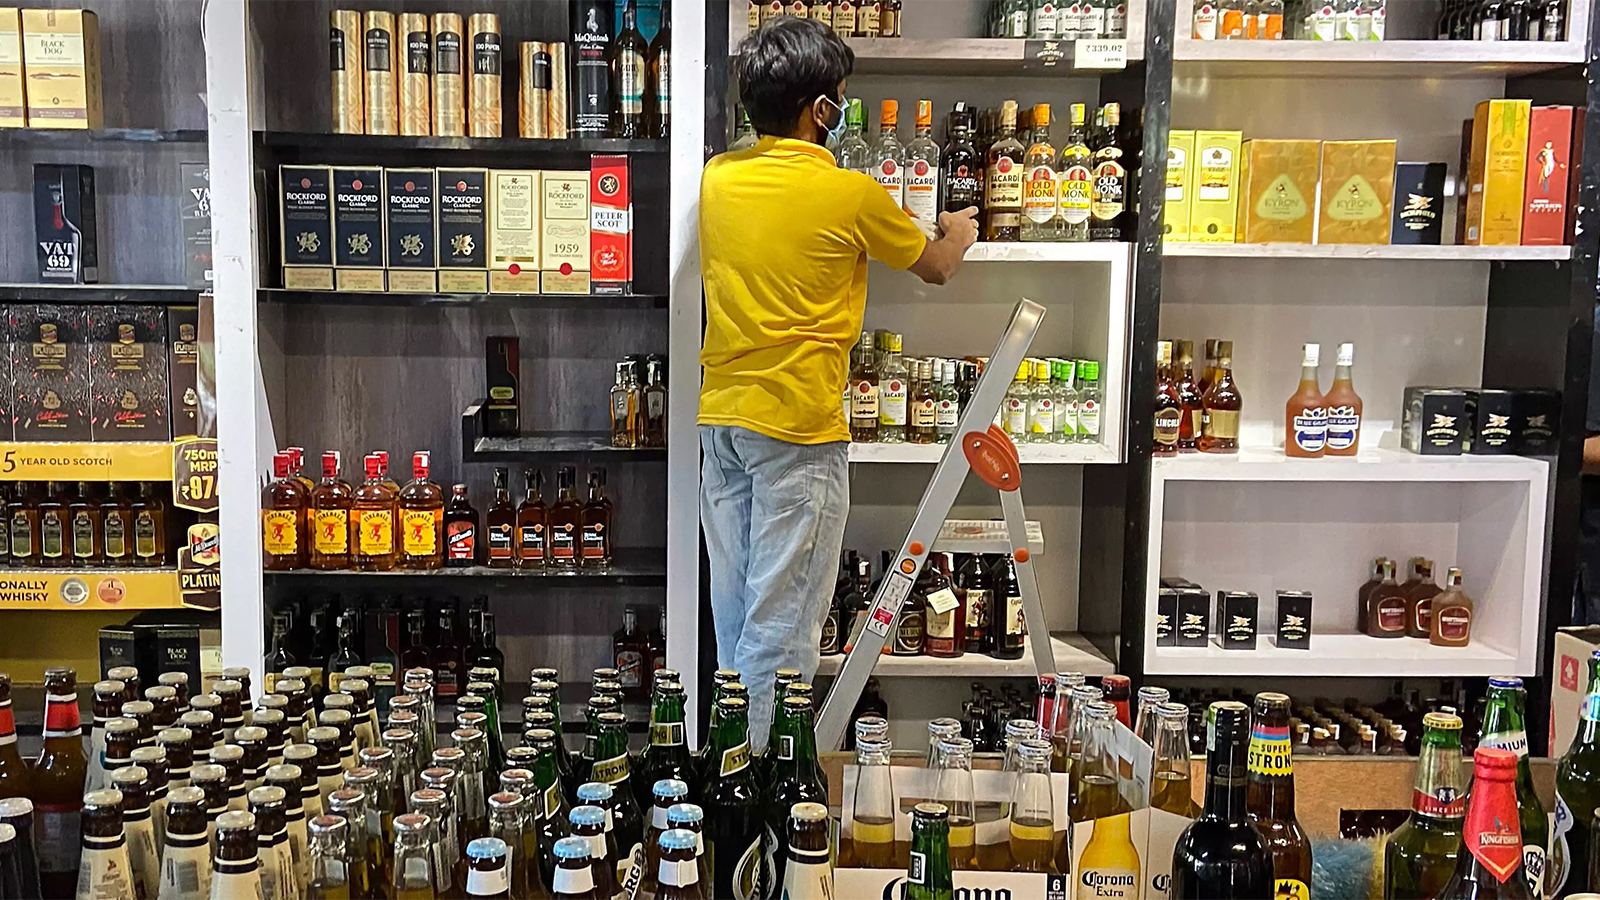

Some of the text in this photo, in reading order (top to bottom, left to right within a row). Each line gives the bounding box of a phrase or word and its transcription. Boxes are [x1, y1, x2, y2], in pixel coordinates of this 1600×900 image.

[1032, 181, 1050, 189] OLD
[1067, 181, 1086, 189] OLD
[1098, 176, 1118, 185] OLD
[1062, 189, 1090, 198] MONK
[1094, 185, 1123, 195] MONK
[286, 192, 327, 201] ROCKFORD
[338, 194, 379, 203] ROCKFORD
[390, 195, 431, 204] ROCKFORD
[442, 195, 482, 204] ROCKFORD
[594, 212, 623, 220] PETER
[596, 220, 620, 228] SCOT
[40, 241, 74, 255] VAT
[554, 243, 580, 253] 1959
[47, 255, 70, 268] 69
[2, 450, 113, 473] 5 YEAR OLD SCOTCH
[189, 460, 218, 472] MRP
[181, 475, 219, 500] ₹97
[0, 592, 49, 601] WHISKY
[1260, 744, 1287, 753] SUPER
[1425, 806, 1448, 814] SINCE
[1479, 832, 1520, 846] KINGFISHER
[1081, 870, 1134, 888] Corona
[1052, 879, 1061, 890] 6
[1096, 886, 1124, 897] Extra
